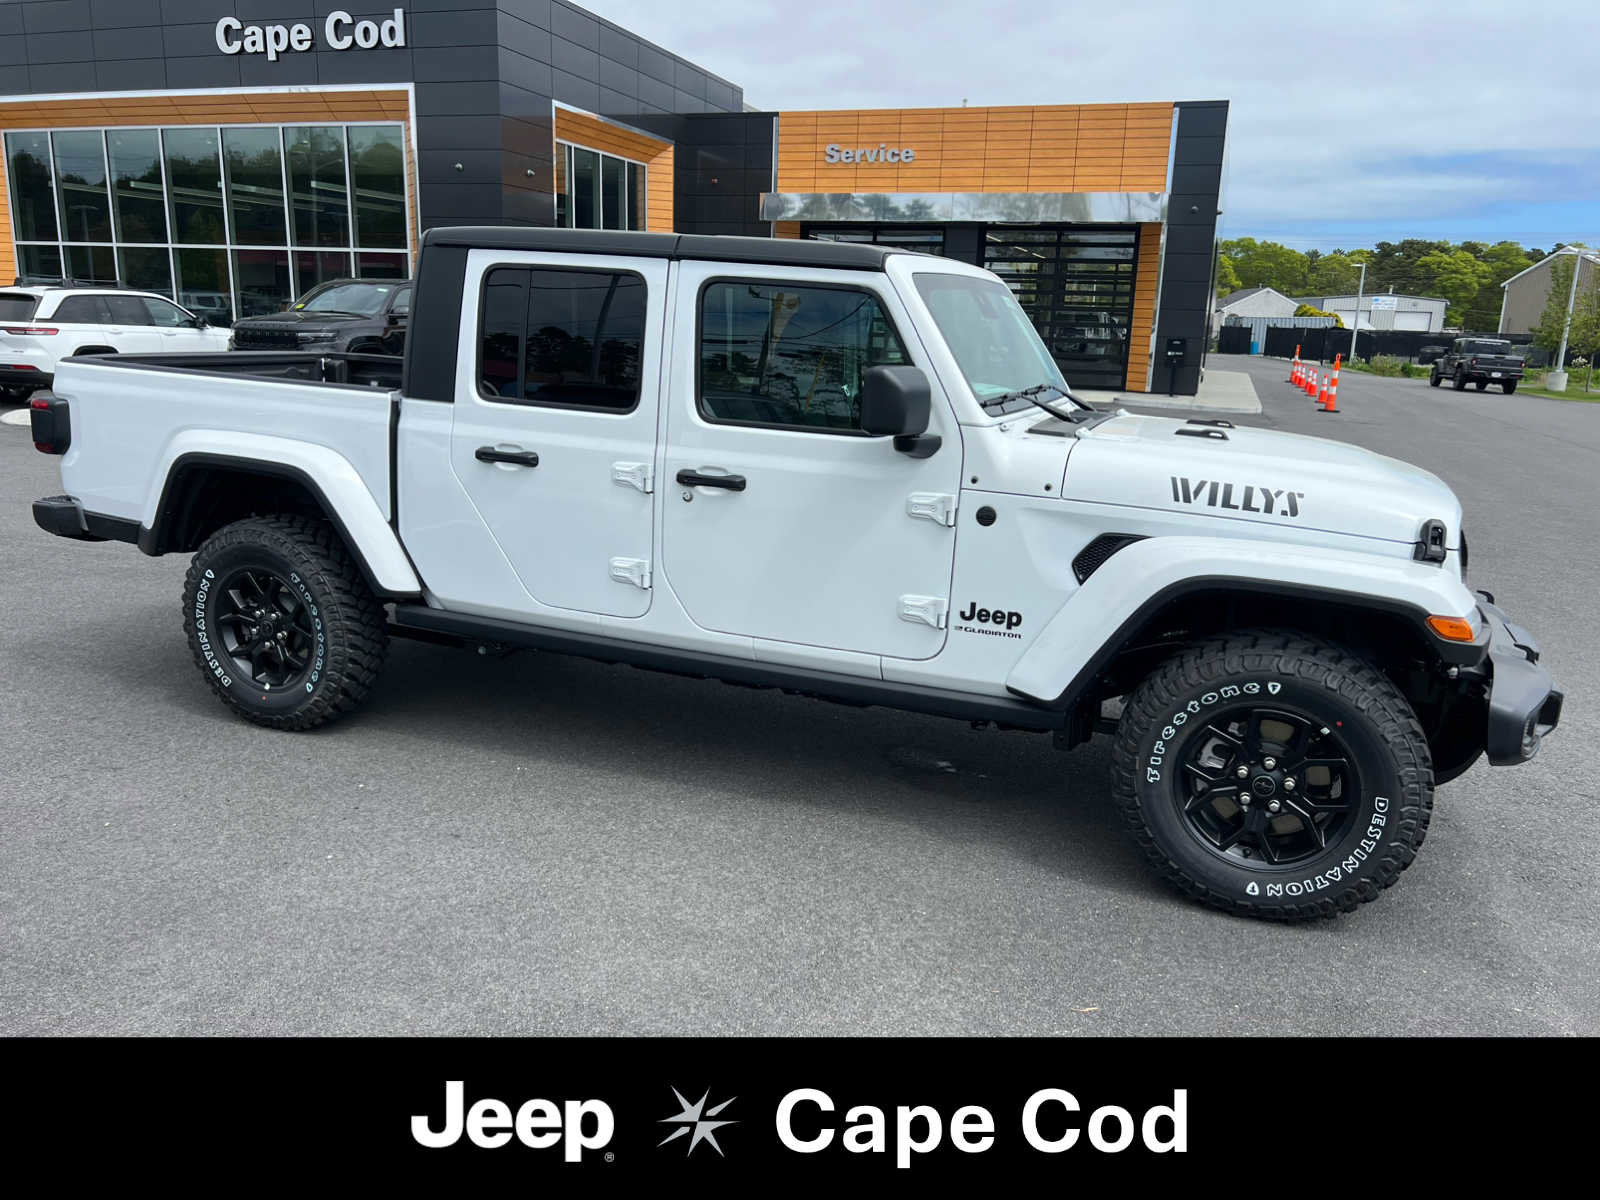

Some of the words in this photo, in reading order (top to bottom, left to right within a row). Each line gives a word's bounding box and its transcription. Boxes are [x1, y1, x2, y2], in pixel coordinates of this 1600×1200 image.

[215, 17, 313, 61] Cape
[324, 8, 406, 50] Cod
[825, 144, 915, 163] Service
[1171, 476, 1304, 517] WILLYS
[195, 579, 232, 688] DESTINATION
[959, 602, 1022, 630] Jeep
[963, 626, 1022, 639] GLADIATOR
[1147, 682, 1260, 783] Firestone
[1266, 796, 1389, 897] DESTINATION
